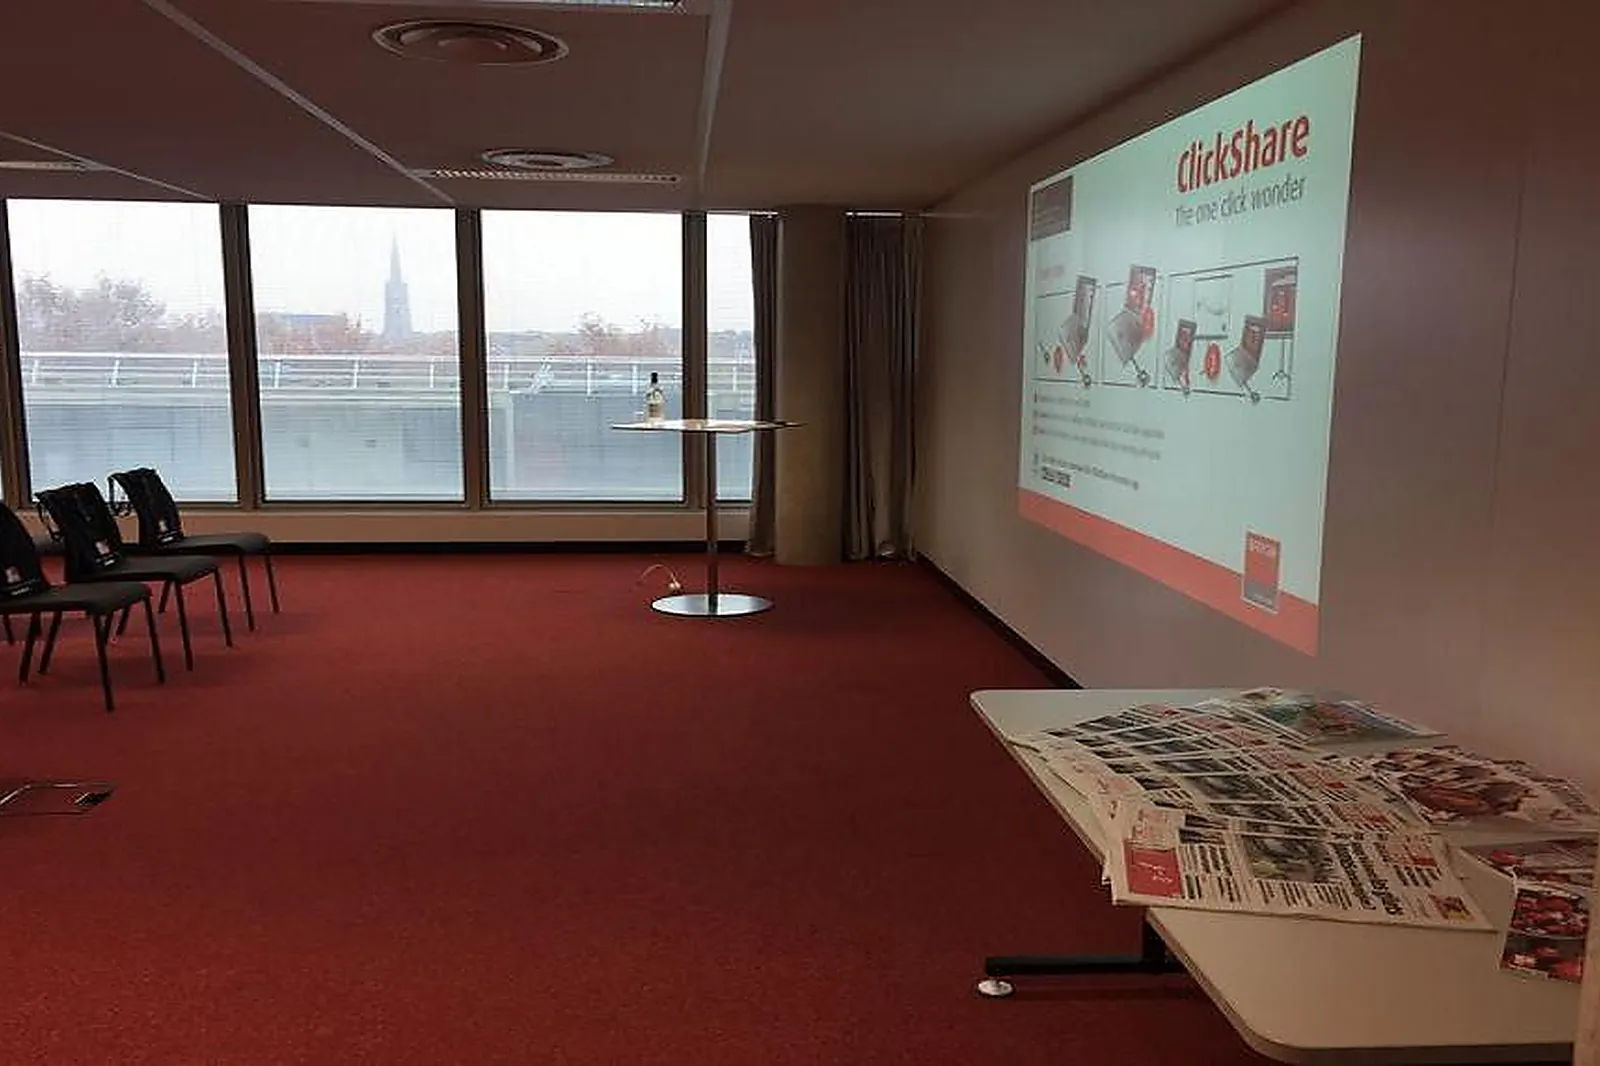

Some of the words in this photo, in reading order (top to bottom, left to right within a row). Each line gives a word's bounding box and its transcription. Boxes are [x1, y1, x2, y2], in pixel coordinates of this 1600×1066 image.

[1177, 115, 1309, 193] ClickShare
[1195, 200, 1219, 224] one
[1219, 185, 1248, 217] click
[1250, 172, 1307, 211] wonder
